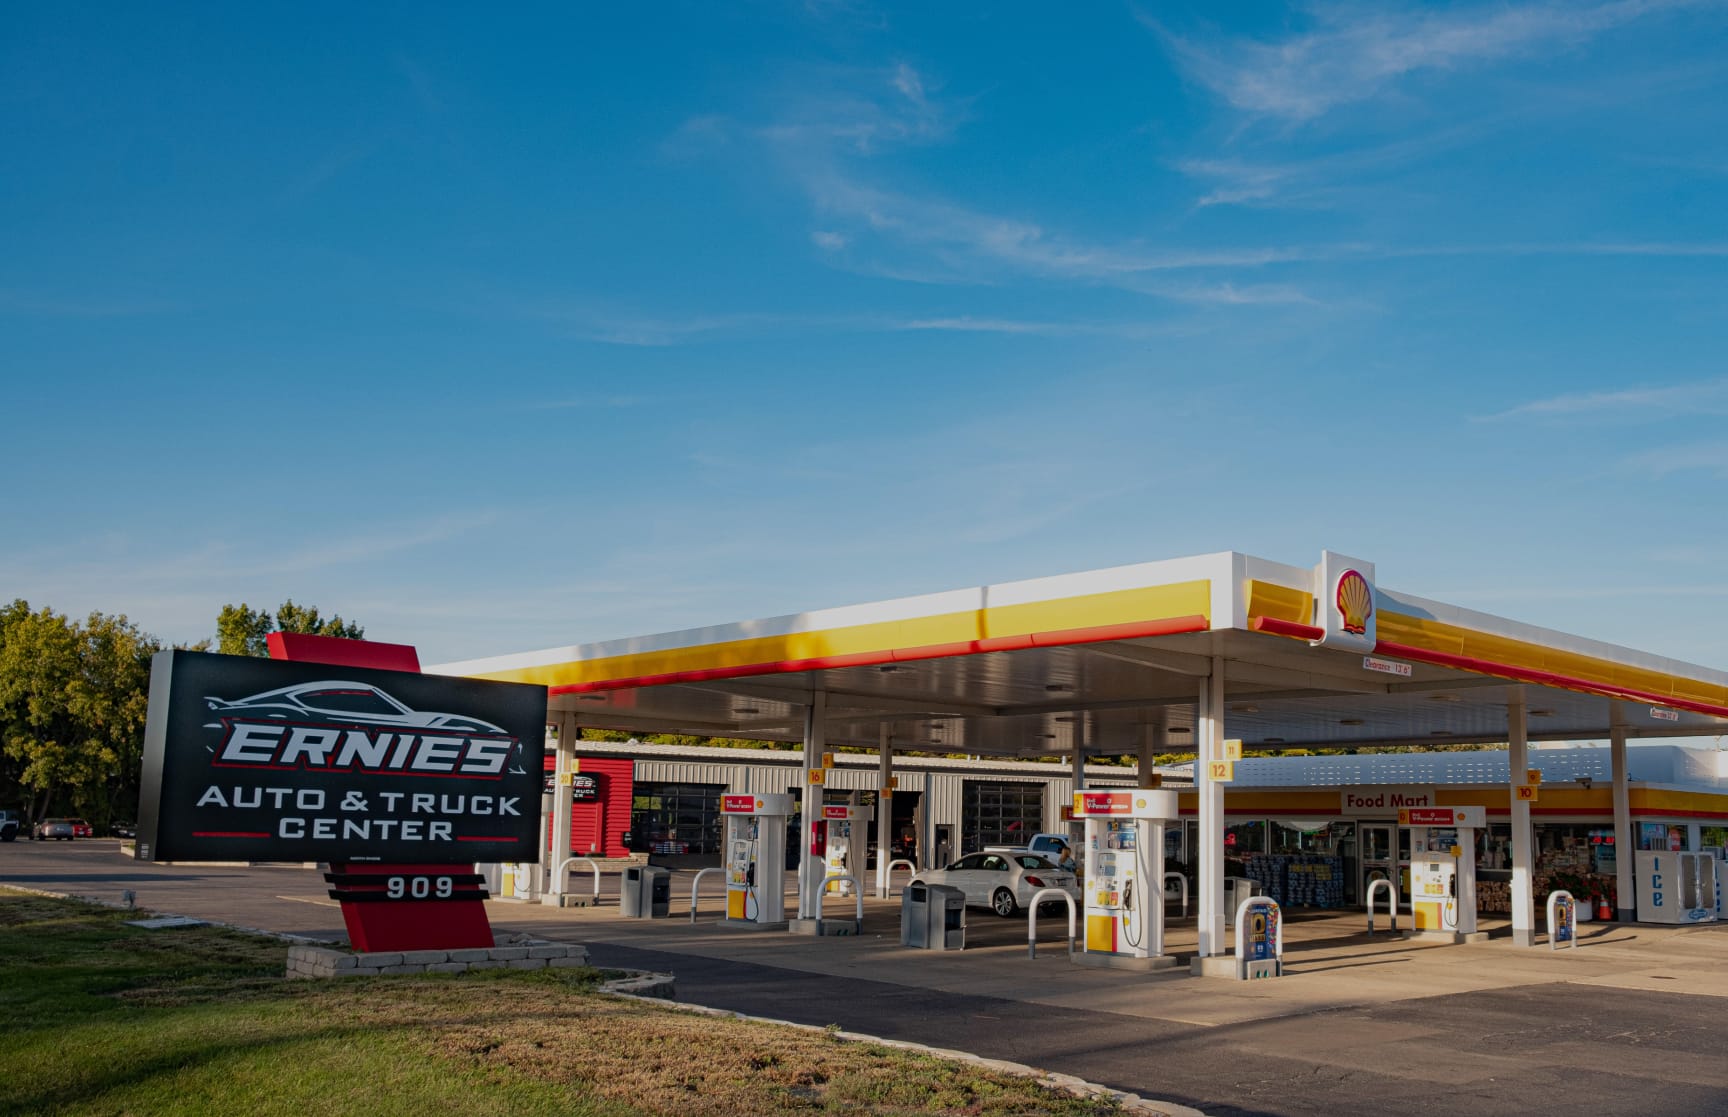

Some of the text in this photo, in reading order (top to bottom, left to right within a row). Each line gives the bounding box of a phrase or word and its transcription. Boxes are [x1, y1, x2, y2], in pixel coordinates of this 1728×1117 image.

[221, 723, 512, 773] ERNIES
[811, 772, 820, 782] 16
[1212, 764, 1226, 777] 12
[196, 786, 521, 816] AUTO & TRUCK
[1347, 793, 1429, 807] Food Mart
[1520, 788, 1532, 798] 10
[279, 818, 453, 841] CENTER
[386, 877, 453, 898] 909
